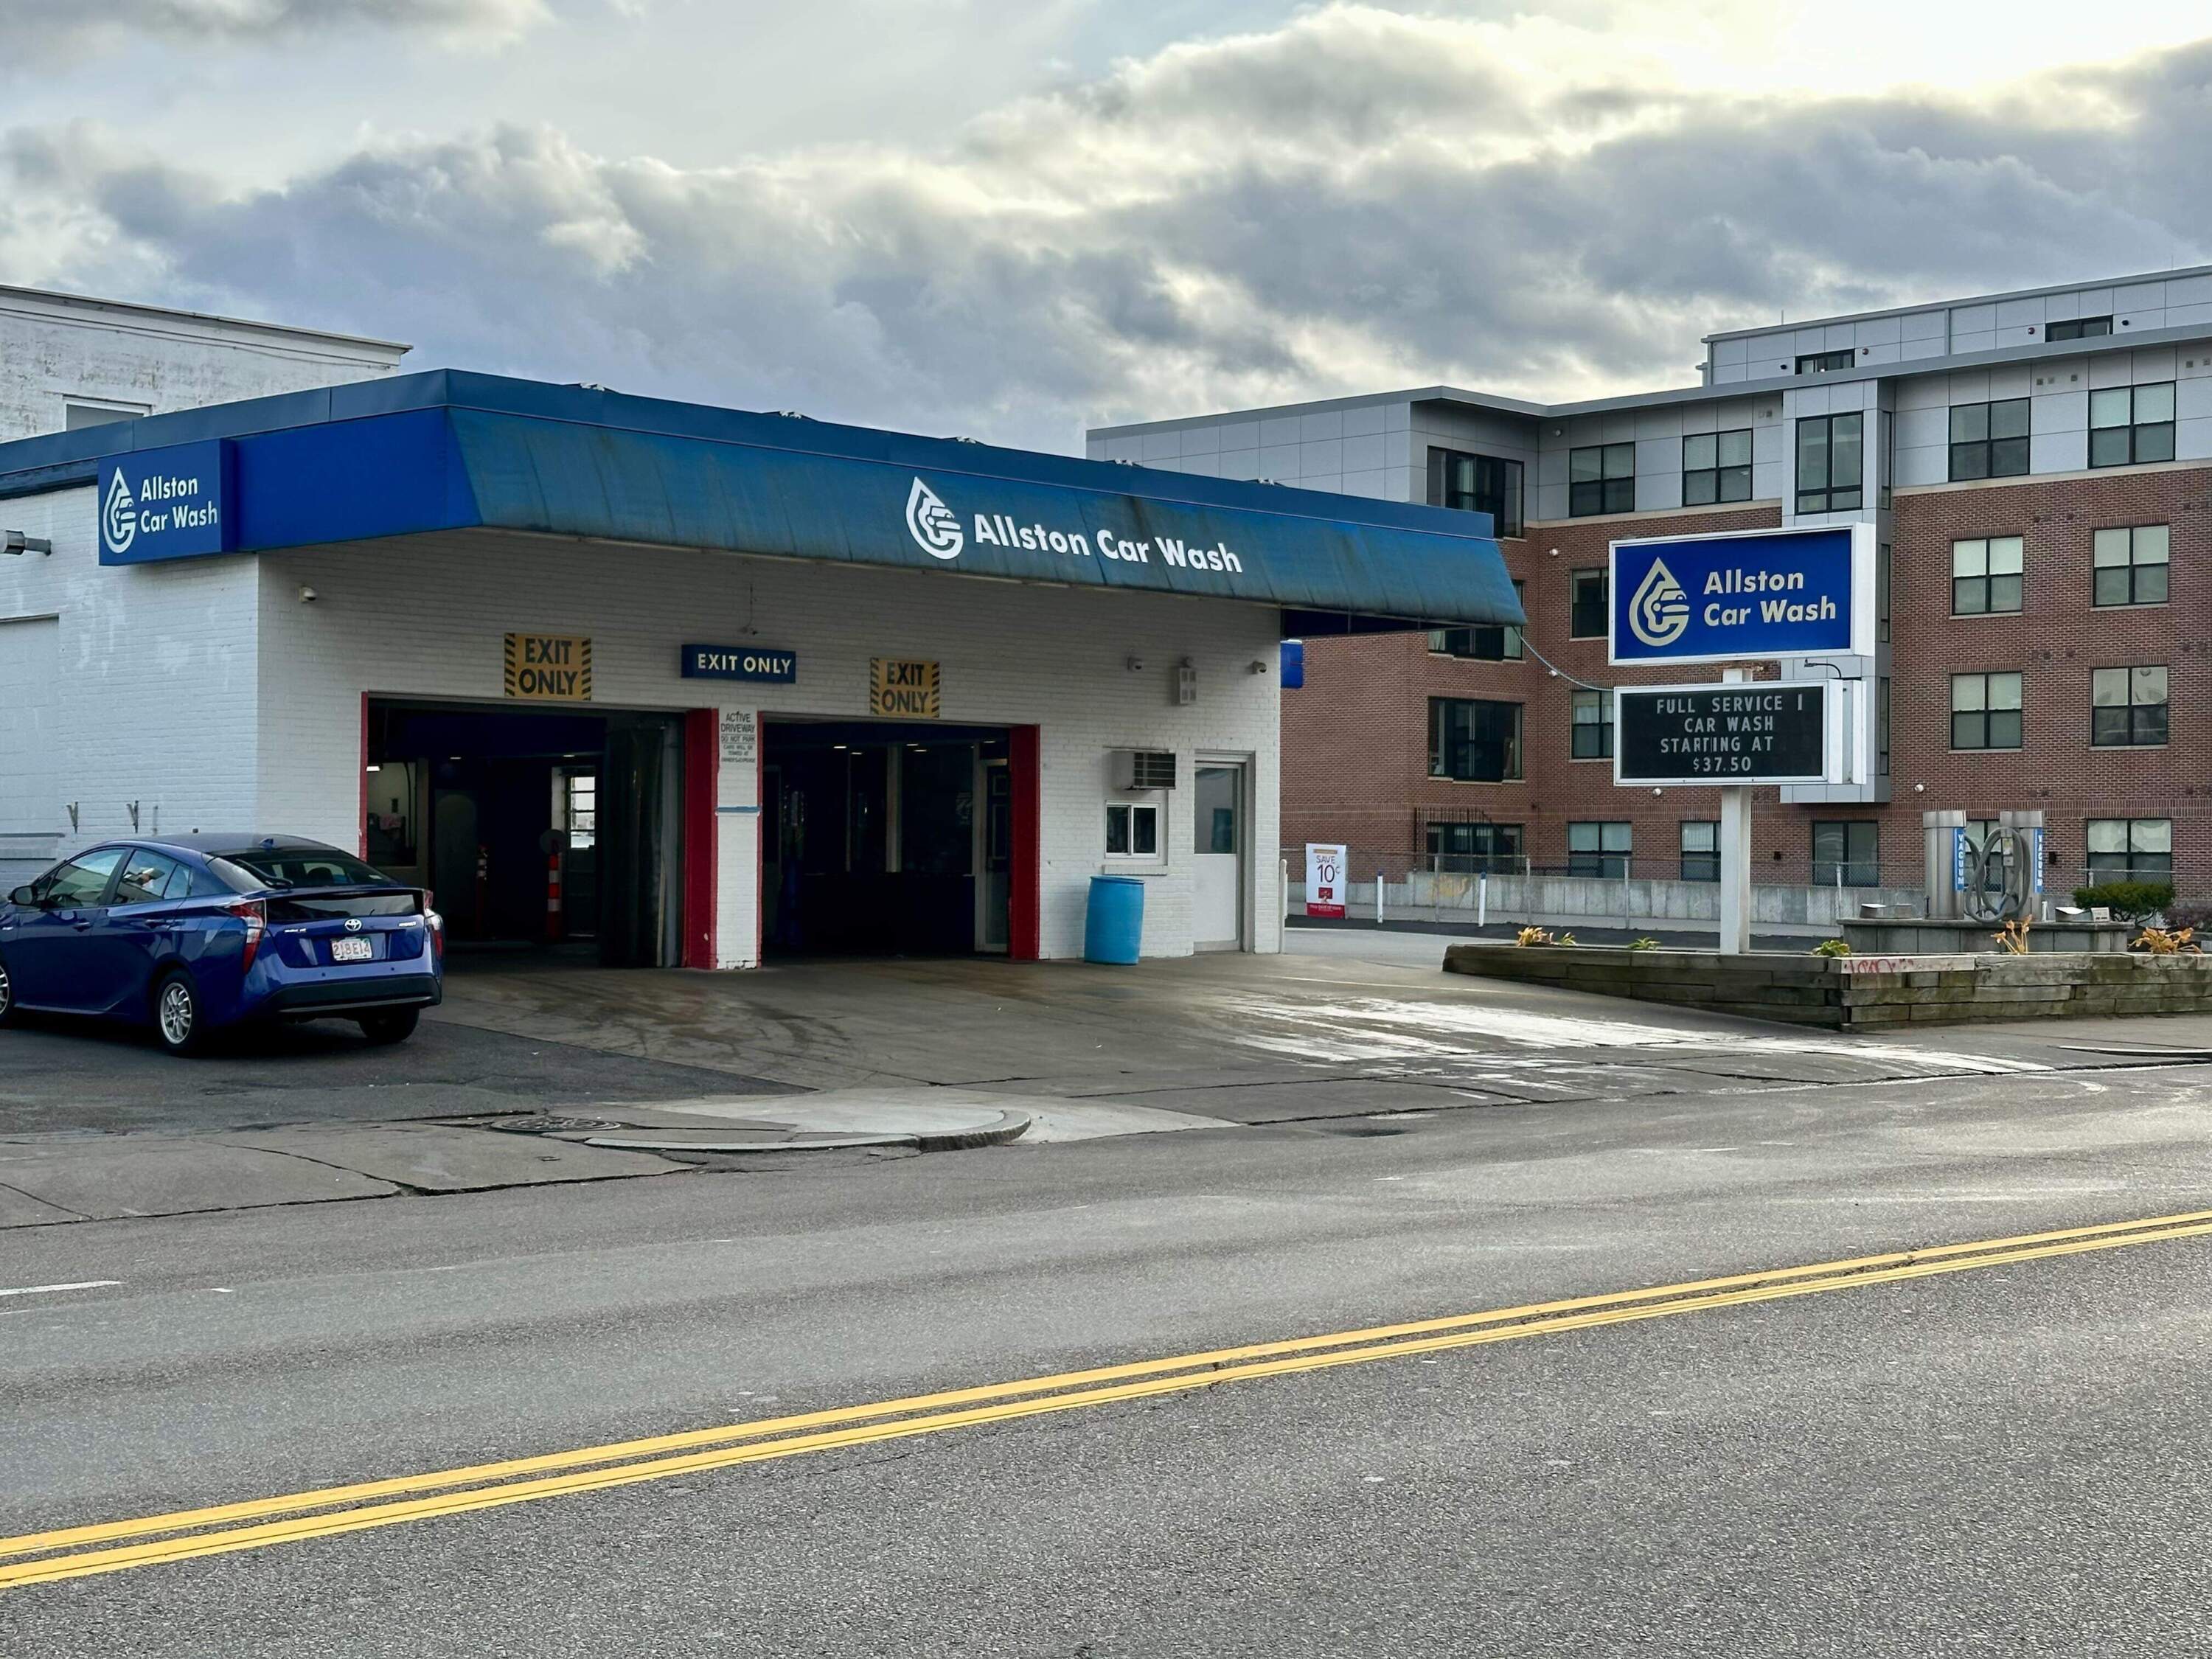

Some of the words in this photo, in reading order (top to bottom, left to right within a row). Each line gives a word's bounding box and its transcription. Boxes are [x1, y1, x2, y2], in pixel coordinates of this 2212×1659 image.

[140, 476, 198, 501] Allston
[140, 509, 168, 533] Car
[172, 501, 218, 529] Wash
[974, 513, 1091, 556] Allston
[1096, 529, 1150, 563] Car
[1154, 537, 1242, 573] Wash
[1703, 569, 1804, 595] Allston
[1704, 603, 1751, 627] Car
[1760, 595, 1836, 623] Wash
[525, 639, 572, 664] EXIT
[698, 653, 737, 671] EXIT
[743, 656, 791, 674] ONLY
[518, 669, 578, 695] ONLY
[887, 662, 925, 686] EXIT
[882, 689, 929, 713] ONLY
[1657, 698, 1696, 714] FULL
[1711, 695, 1783, 712] SERVICE
[720, 723, 755, 732] DRIVEWAY
[726, 711, 751, 722] ACTIVE
[1684, 717, 1716, 733] CAR
[1727, 716, 1773, 732] WASH
[1660, 737, 1741, 753] STARTING
[1752, 736, 1773, 751] AT
[1693, 757, 1751, 772] $37.50
[1316, 855, 1335, 863] SAVE
